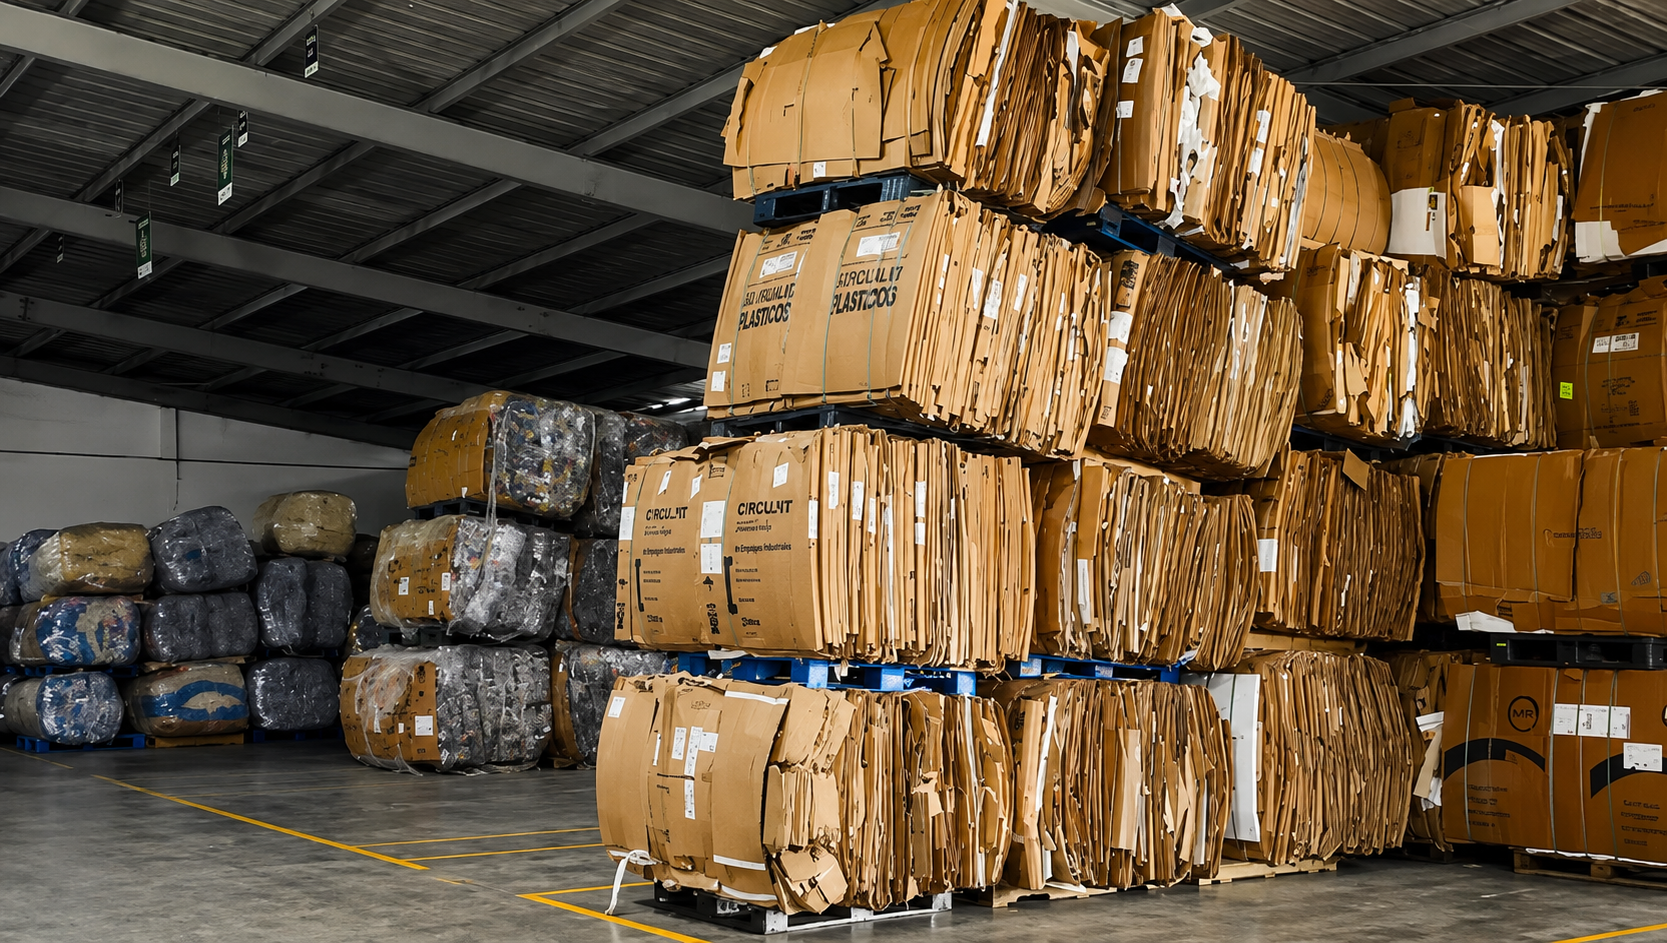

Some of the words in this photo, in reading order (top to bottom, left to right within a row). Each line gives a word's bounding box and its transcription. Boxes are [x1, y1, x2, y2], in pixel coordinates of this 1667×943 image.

[830, 285, 897, 315] PLASTICOS
[738, 302, 791, 331] PLASTICOS
[1513, 709, 1533, 718] MR
